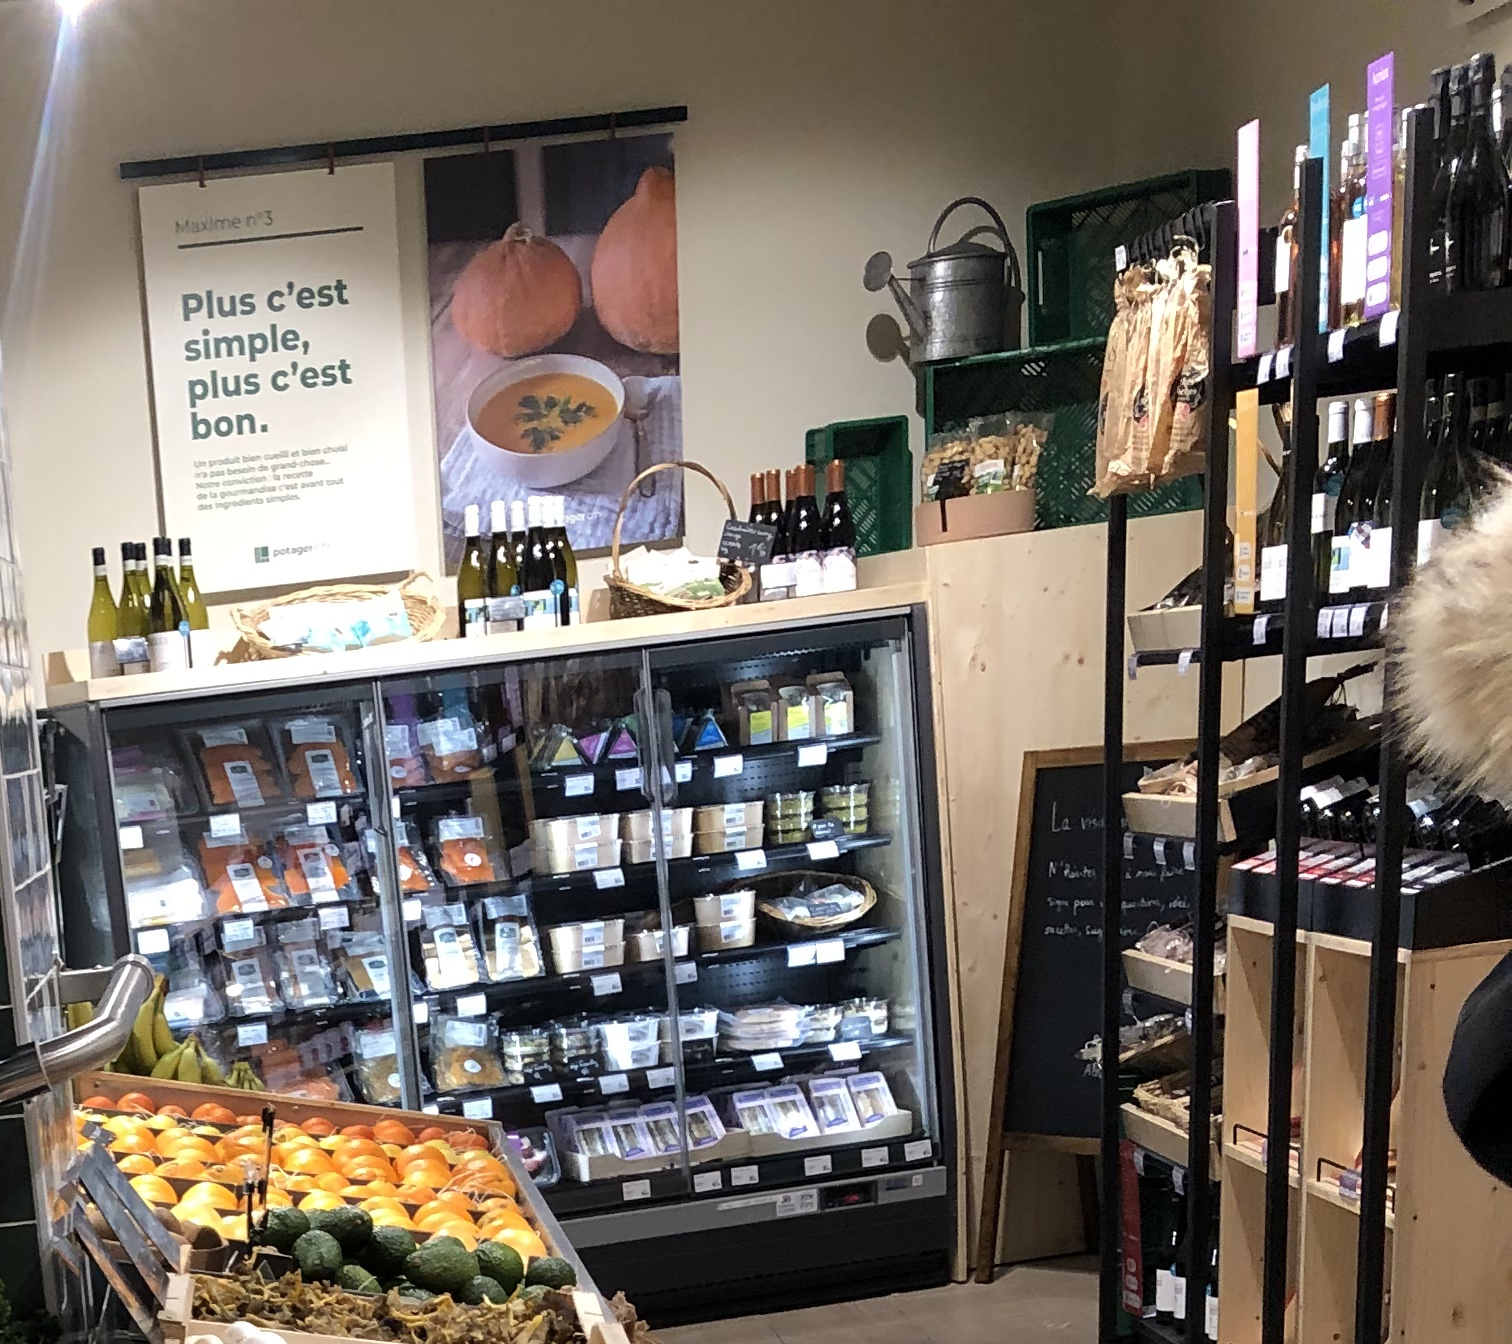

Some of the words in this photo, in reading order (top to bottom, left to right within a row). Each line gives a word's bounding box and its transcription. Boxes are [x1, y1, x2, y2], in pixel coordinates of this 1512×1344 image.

[175, 216, 241, 234] Maxime
[246, 210, 273, 228] n°3
[182, 289, 256, 321] Plus
[267, 279, 349, 313] c'est
[184, 323, 310, 362] simple,
[188, 369, 261, 408] plus
[271, 359, 353, 392] c'est
[190, 411, 269, 440] bon.
[209, 456, 240, 467] produit
[242, 454, 261, 463] bien
[302, 448, 321, 456] bien
[196, 481, 220, 489] Notre
[222, 476, 267, 487] conviction
[283, 471, 313, 480] recette
[210, 470, 225, 478] pas
[227, 466, 256, 475] besoin
[219, 485, 276, 499] gourmandise
[301, 480, 324, 489] avant
[326, 478, 344, 486] tout
